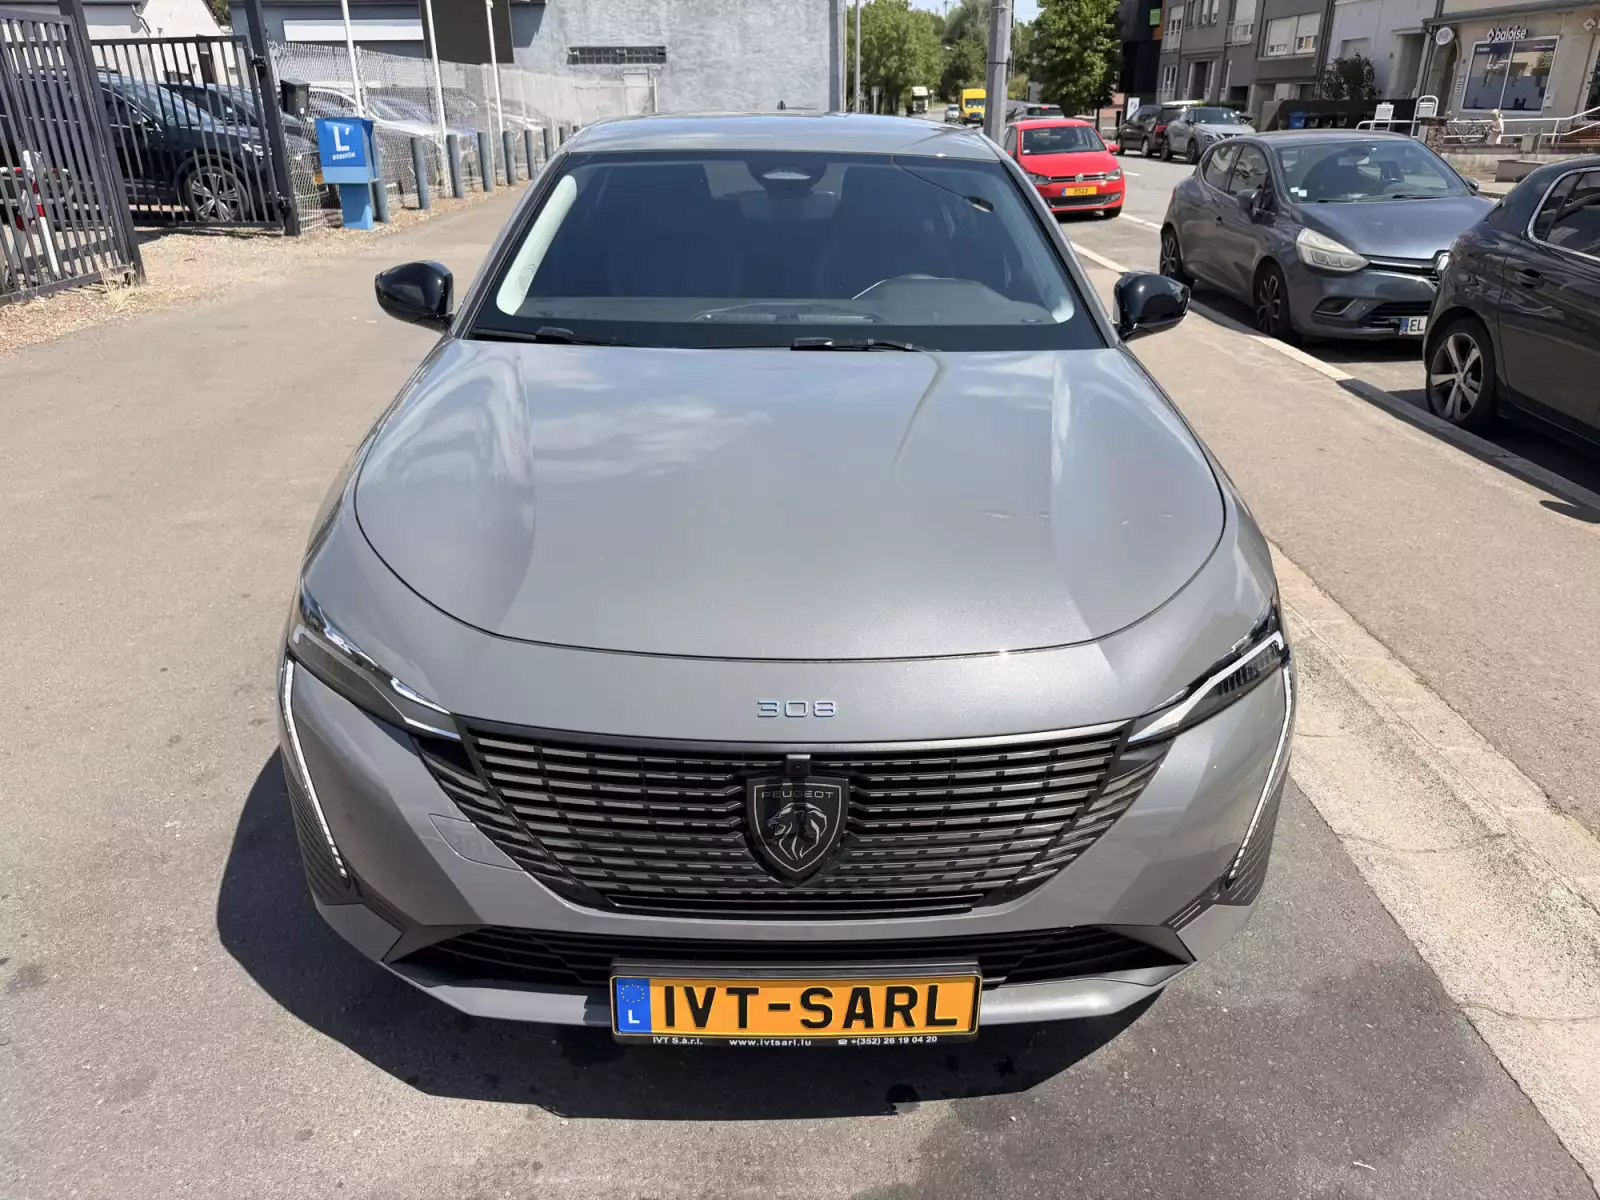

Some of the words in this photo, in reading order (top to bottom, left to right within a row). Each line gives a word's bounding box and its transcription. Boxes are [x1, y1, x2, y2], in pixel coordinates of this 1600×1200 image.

[1495, 25, 1527, 41] baloise
[757, 699, 837, 718] 308
[761, 790, 835, 800] PEUGEOT
[664, 984, 958, 1029] IVT-SARL
[628, 1009, 640, 1024] L
[653, 1036, 669, 1045] IVT
[729, 1038, 812, 1047] www.ivtsarl.lu
[850, 1037, 881, 1046] +(352)
[883, 1037, 895, 1045] 26
[911, 1036, 923, 1044] 04
[926, 1035, 938, 1043] 20
